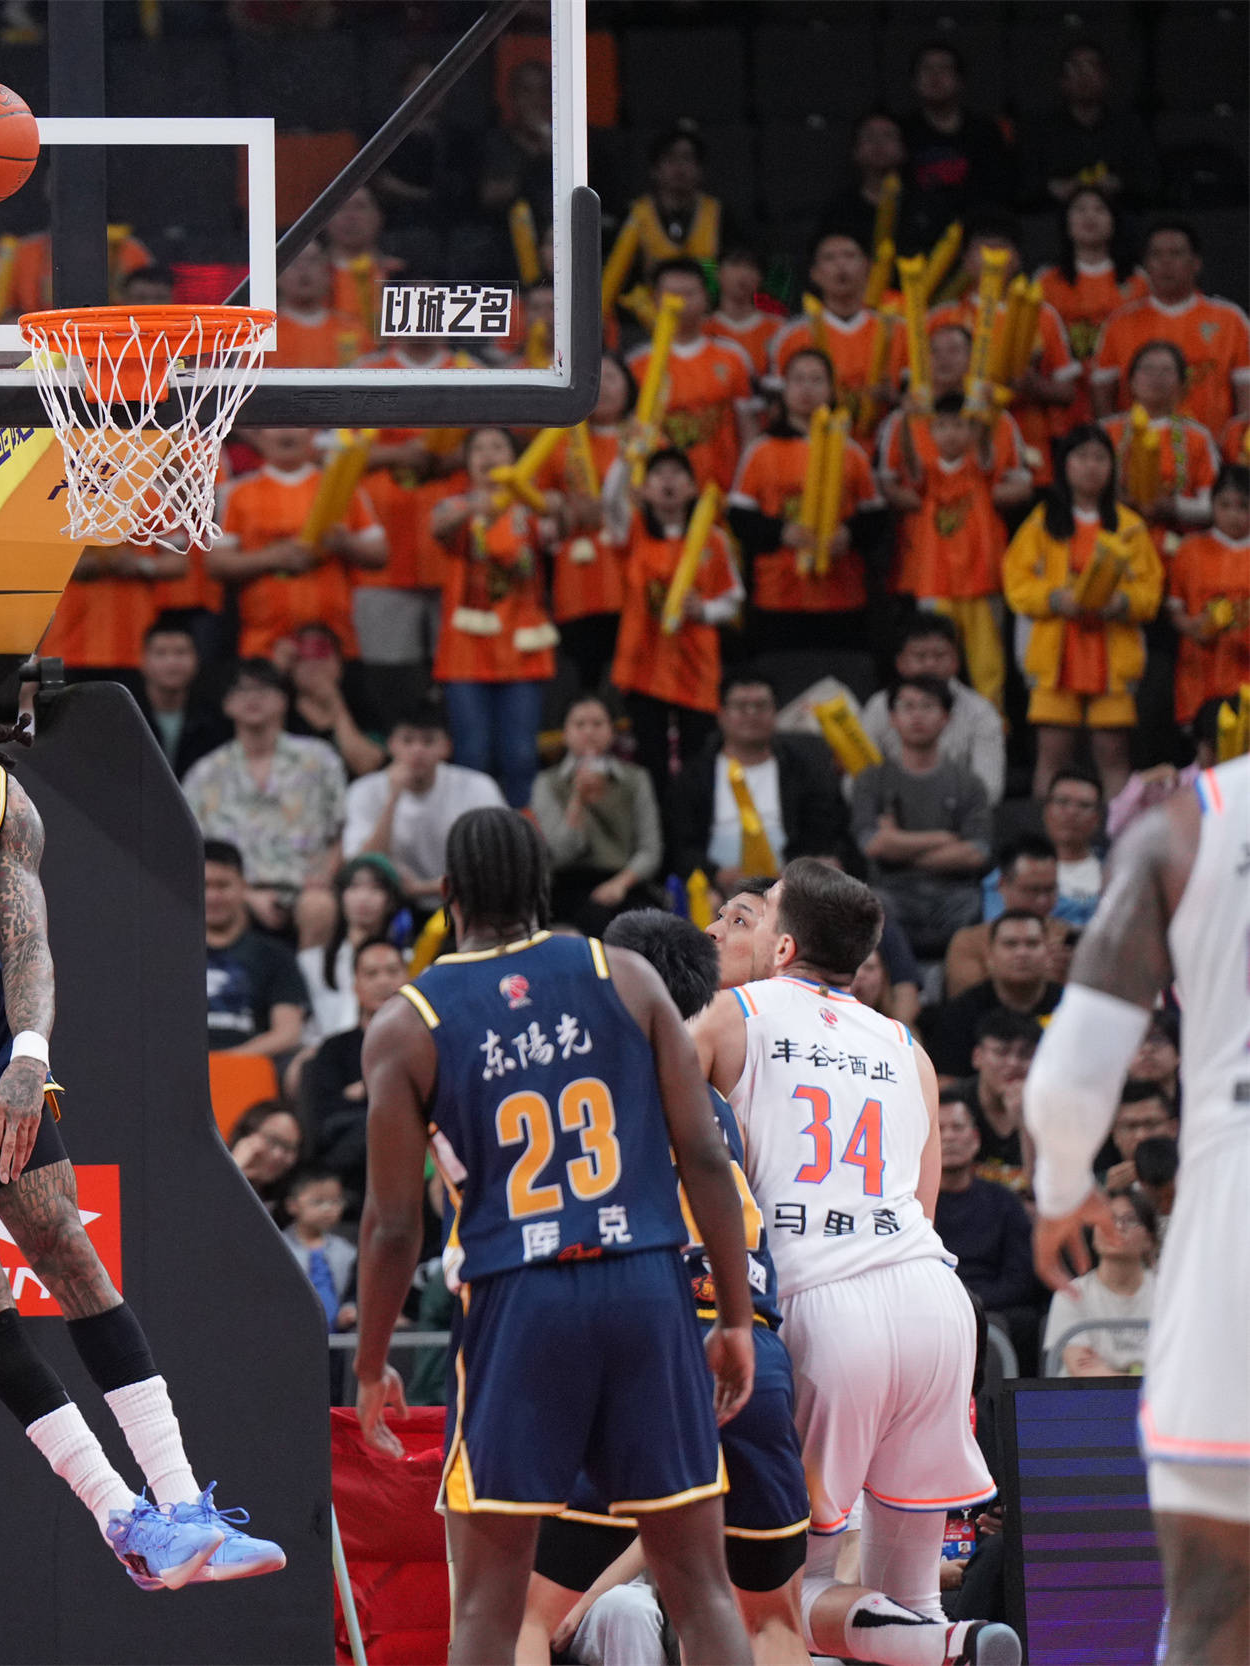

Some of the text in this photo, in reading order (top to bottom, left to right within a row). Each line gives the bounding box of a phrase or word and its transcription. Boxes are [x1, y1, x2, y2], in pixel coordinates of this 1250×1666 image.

[381, 285, 512, 336] 以城之名
[771, 1037, 897, 1084] 丰谷酒业
[495, 1076, 622, 1220] 23
[791, 1083, 886, 1198] 34
